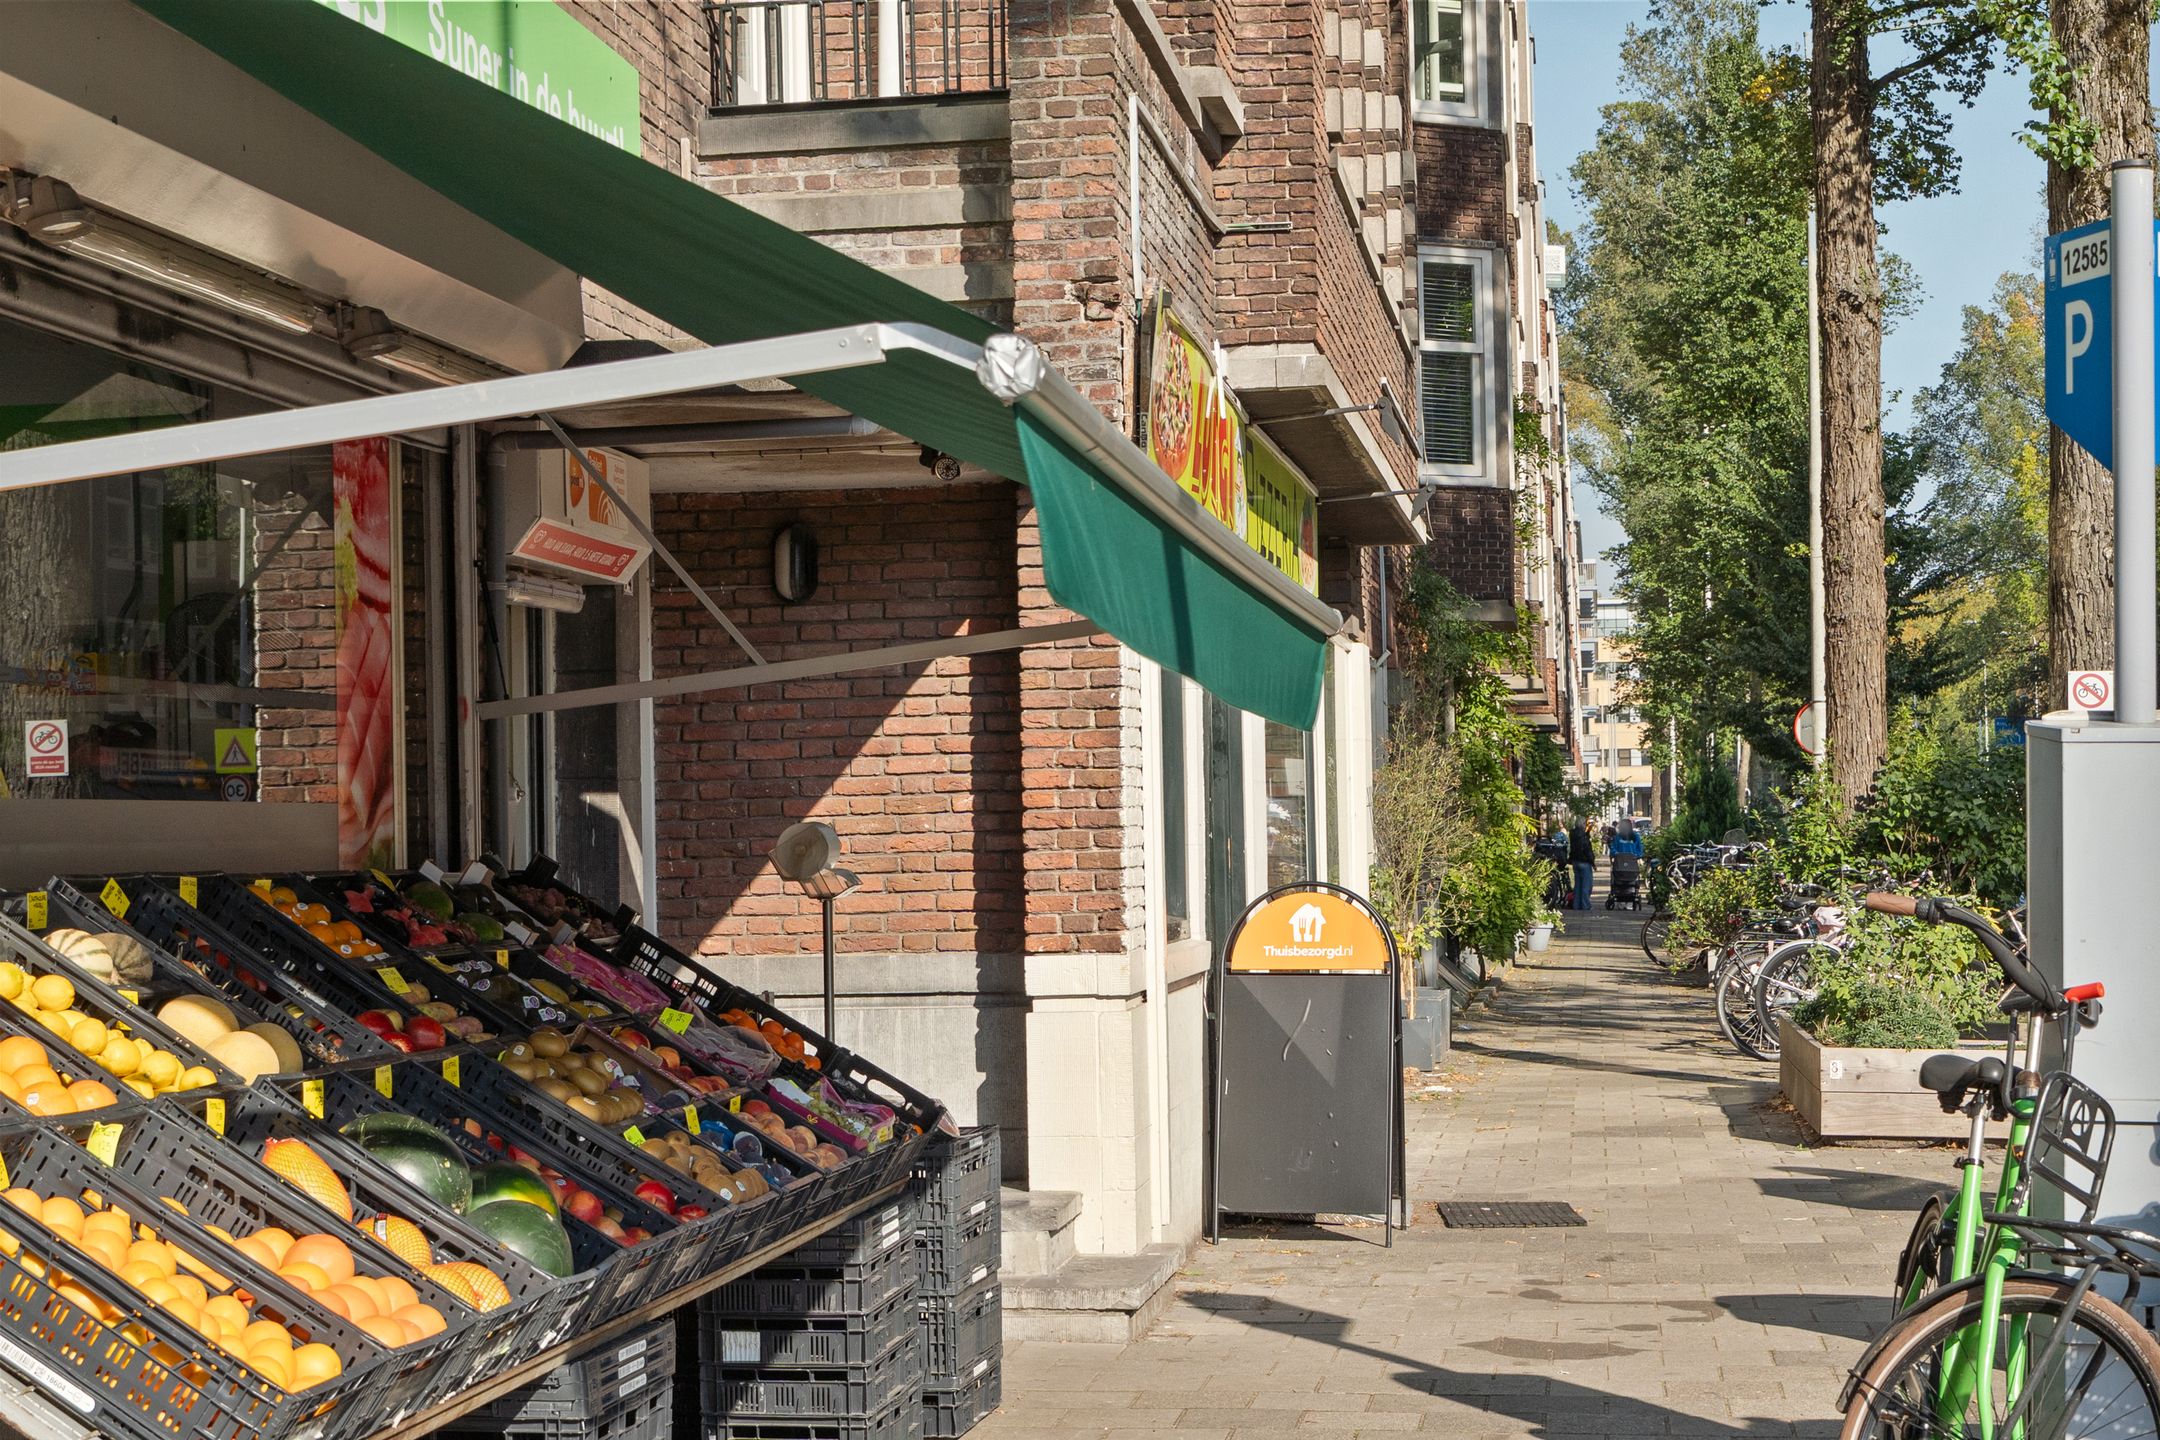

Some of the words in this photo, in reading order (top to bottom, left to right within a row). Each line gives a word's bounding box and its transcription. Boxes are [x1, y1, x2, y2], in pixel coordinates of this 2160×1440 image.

[428, 0, 503, 90] Super
[2064, 239, 2108, 276] 12585
[2065, 299, 2094, 395] P
[1263, 945, 1354, 960] Thuisbezorgd.nl
